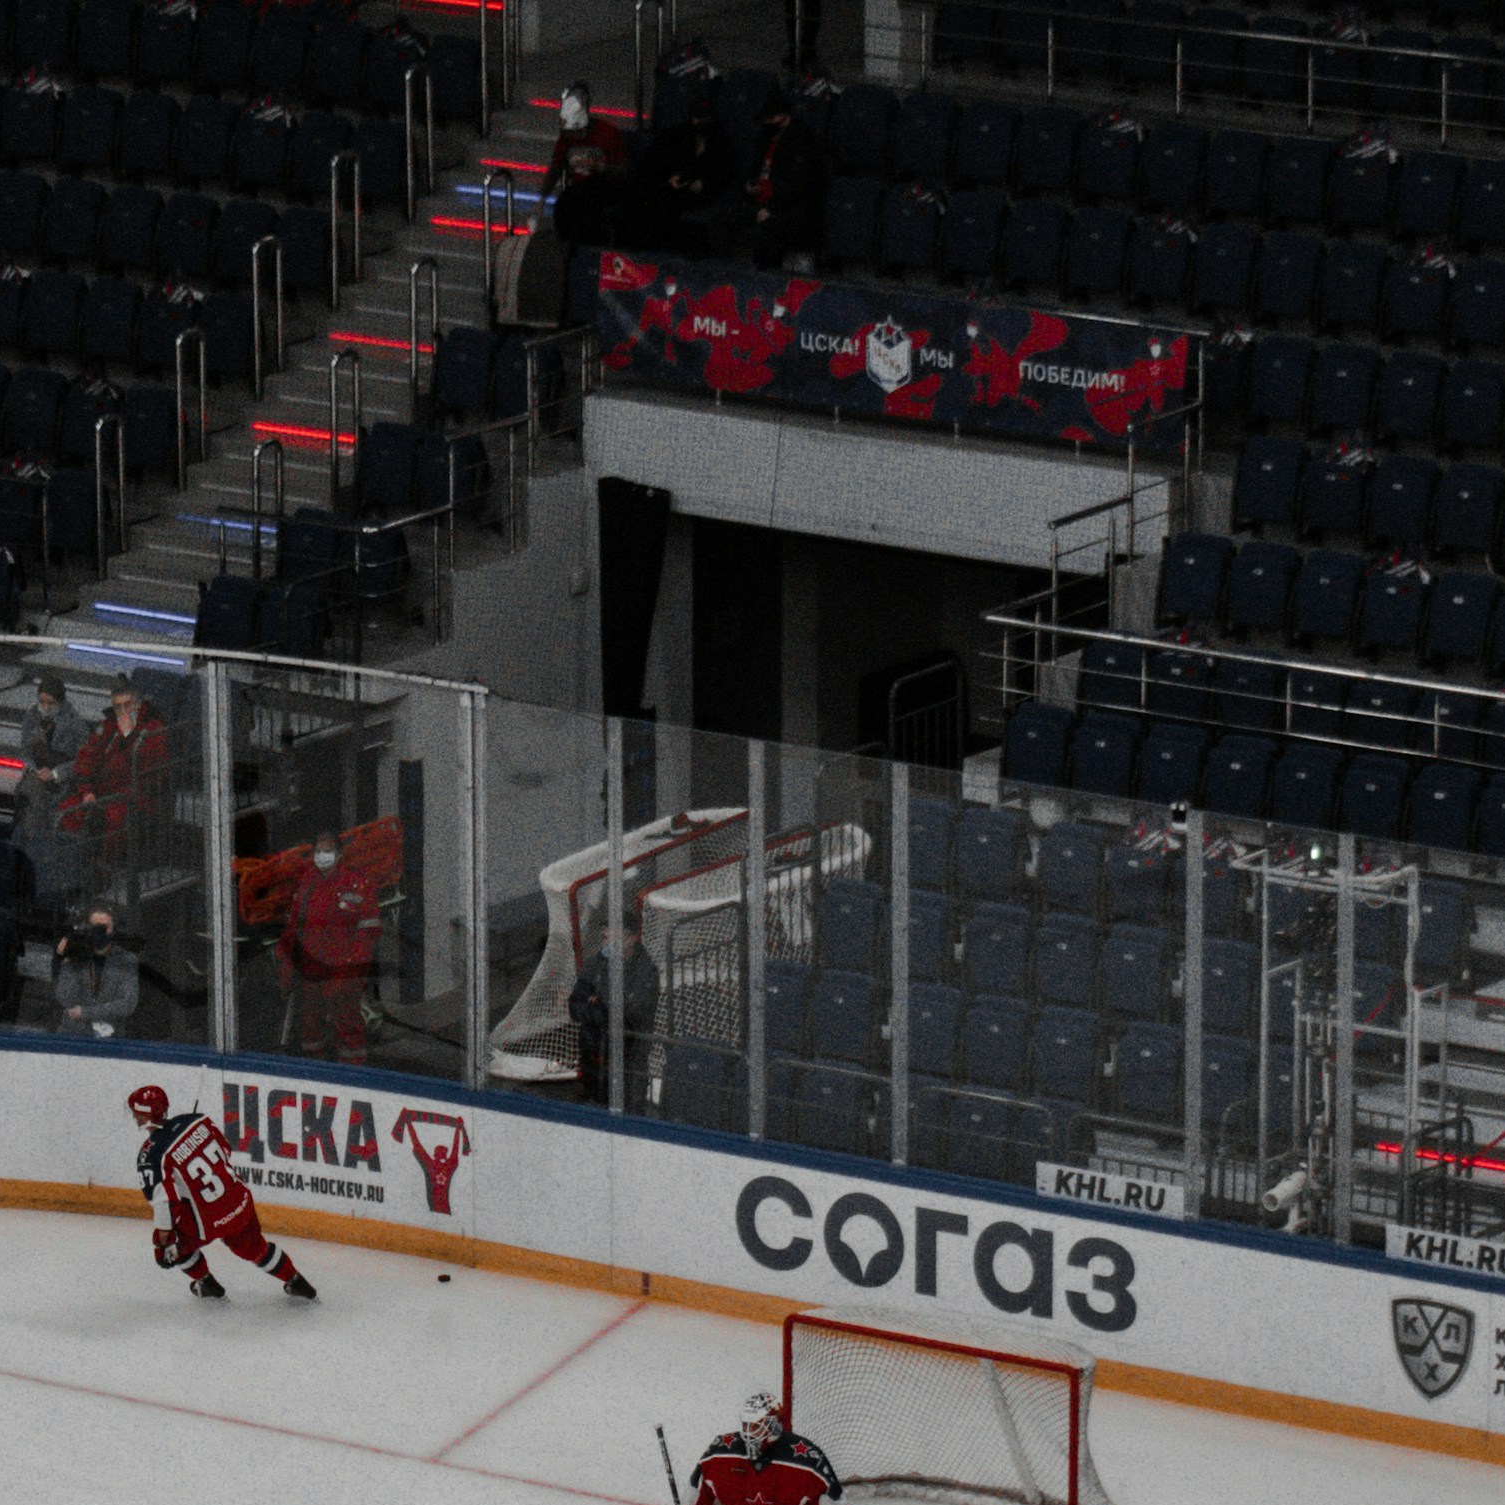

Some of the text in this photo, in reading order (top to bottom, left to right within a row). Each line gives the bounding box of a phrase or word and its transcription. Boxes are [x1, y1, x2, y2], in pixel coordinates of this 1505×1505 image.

[693, 315, 727, 337] МЫ
[800, 331, 860, 356] ЦСКА!
[919, 347, 954, 369] МЫ
[1018, 361, 1125, 391] ПОБЕДИМ!
[222, 1082, 383, 1173] ЦСКА
[186, 1138, 230, 1203] 37
[233, 1165, 385, 1204] WW.CSKA-HOCKEY.RU
[1054, 1168, 1166, 1212] KHL.RU
